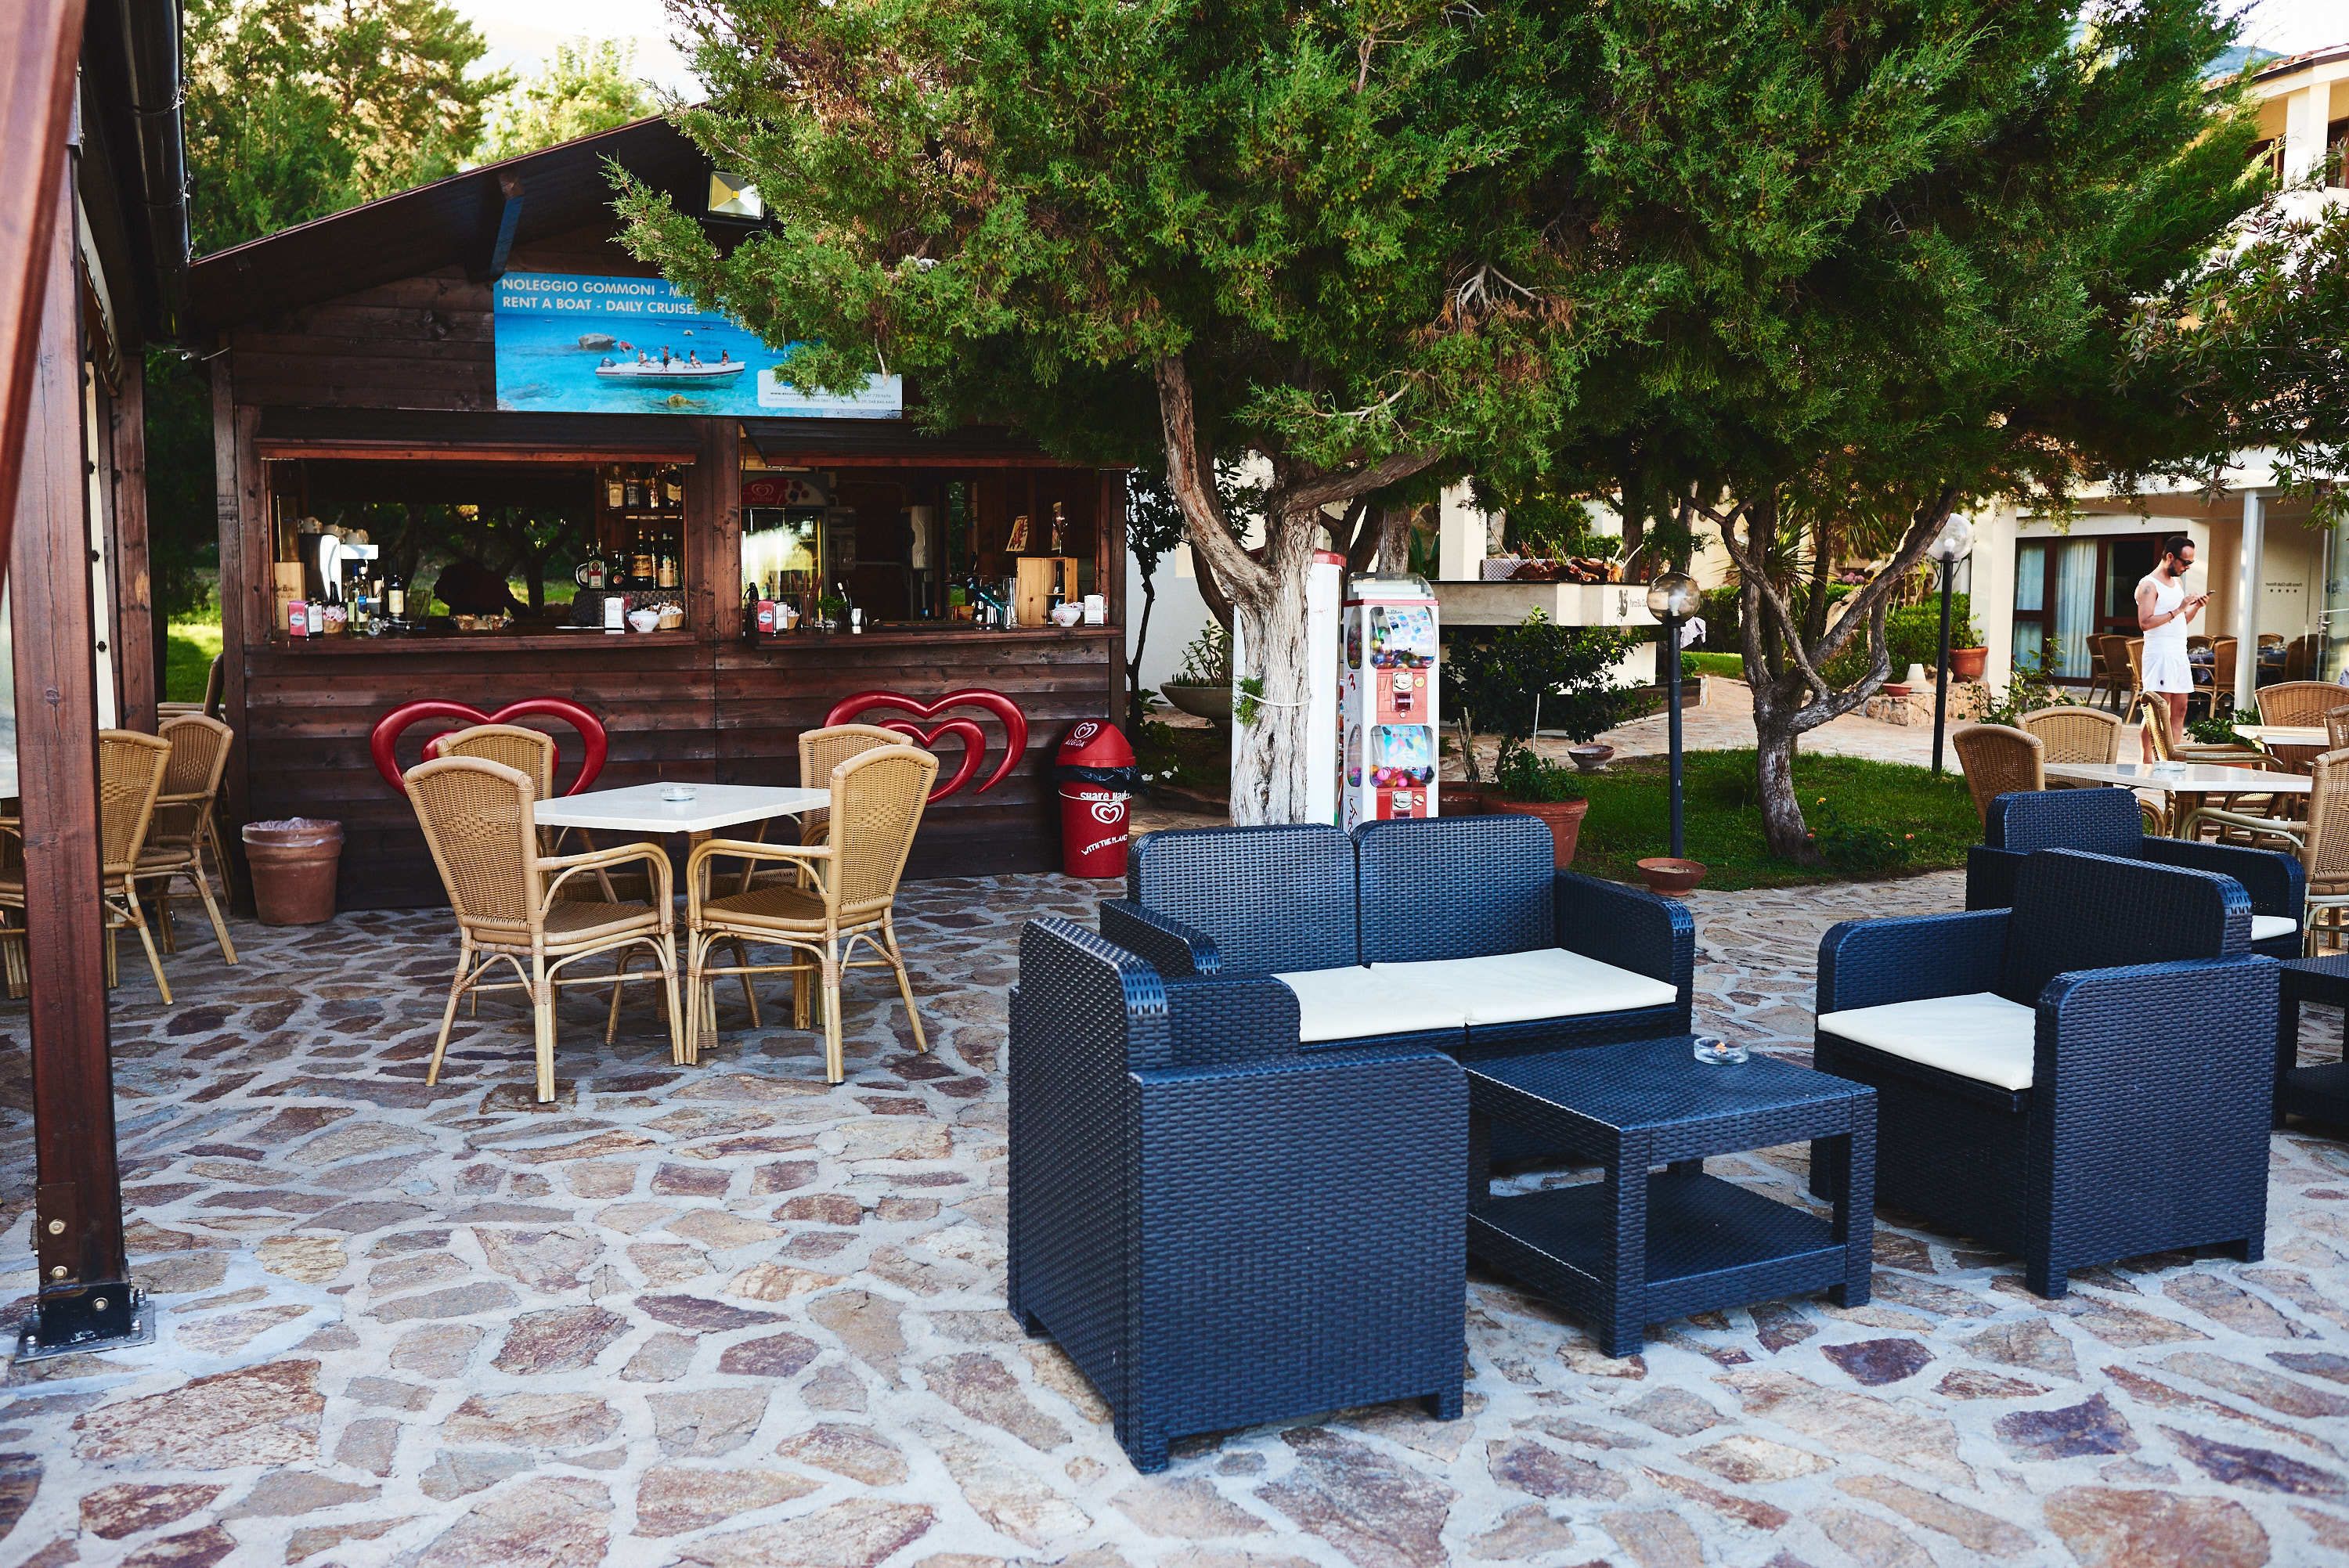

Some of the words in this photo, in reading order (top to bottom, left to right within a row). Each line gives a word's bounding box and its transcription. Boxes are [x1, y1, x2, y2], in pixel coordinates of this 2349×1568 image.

[502, 279, 579, 292] NOLEGGIO
[582, 282, 655, 296] GOMMONI
[503, 297, 538, 308] RENT
[542, 298, 553, 309] A
[557, 298, 593, 310] BOAT
[606, 300, 644, 312] DAILY
[1081, 842, 1100, 856] WITH
[1099, 838, 1113, 847] THE
